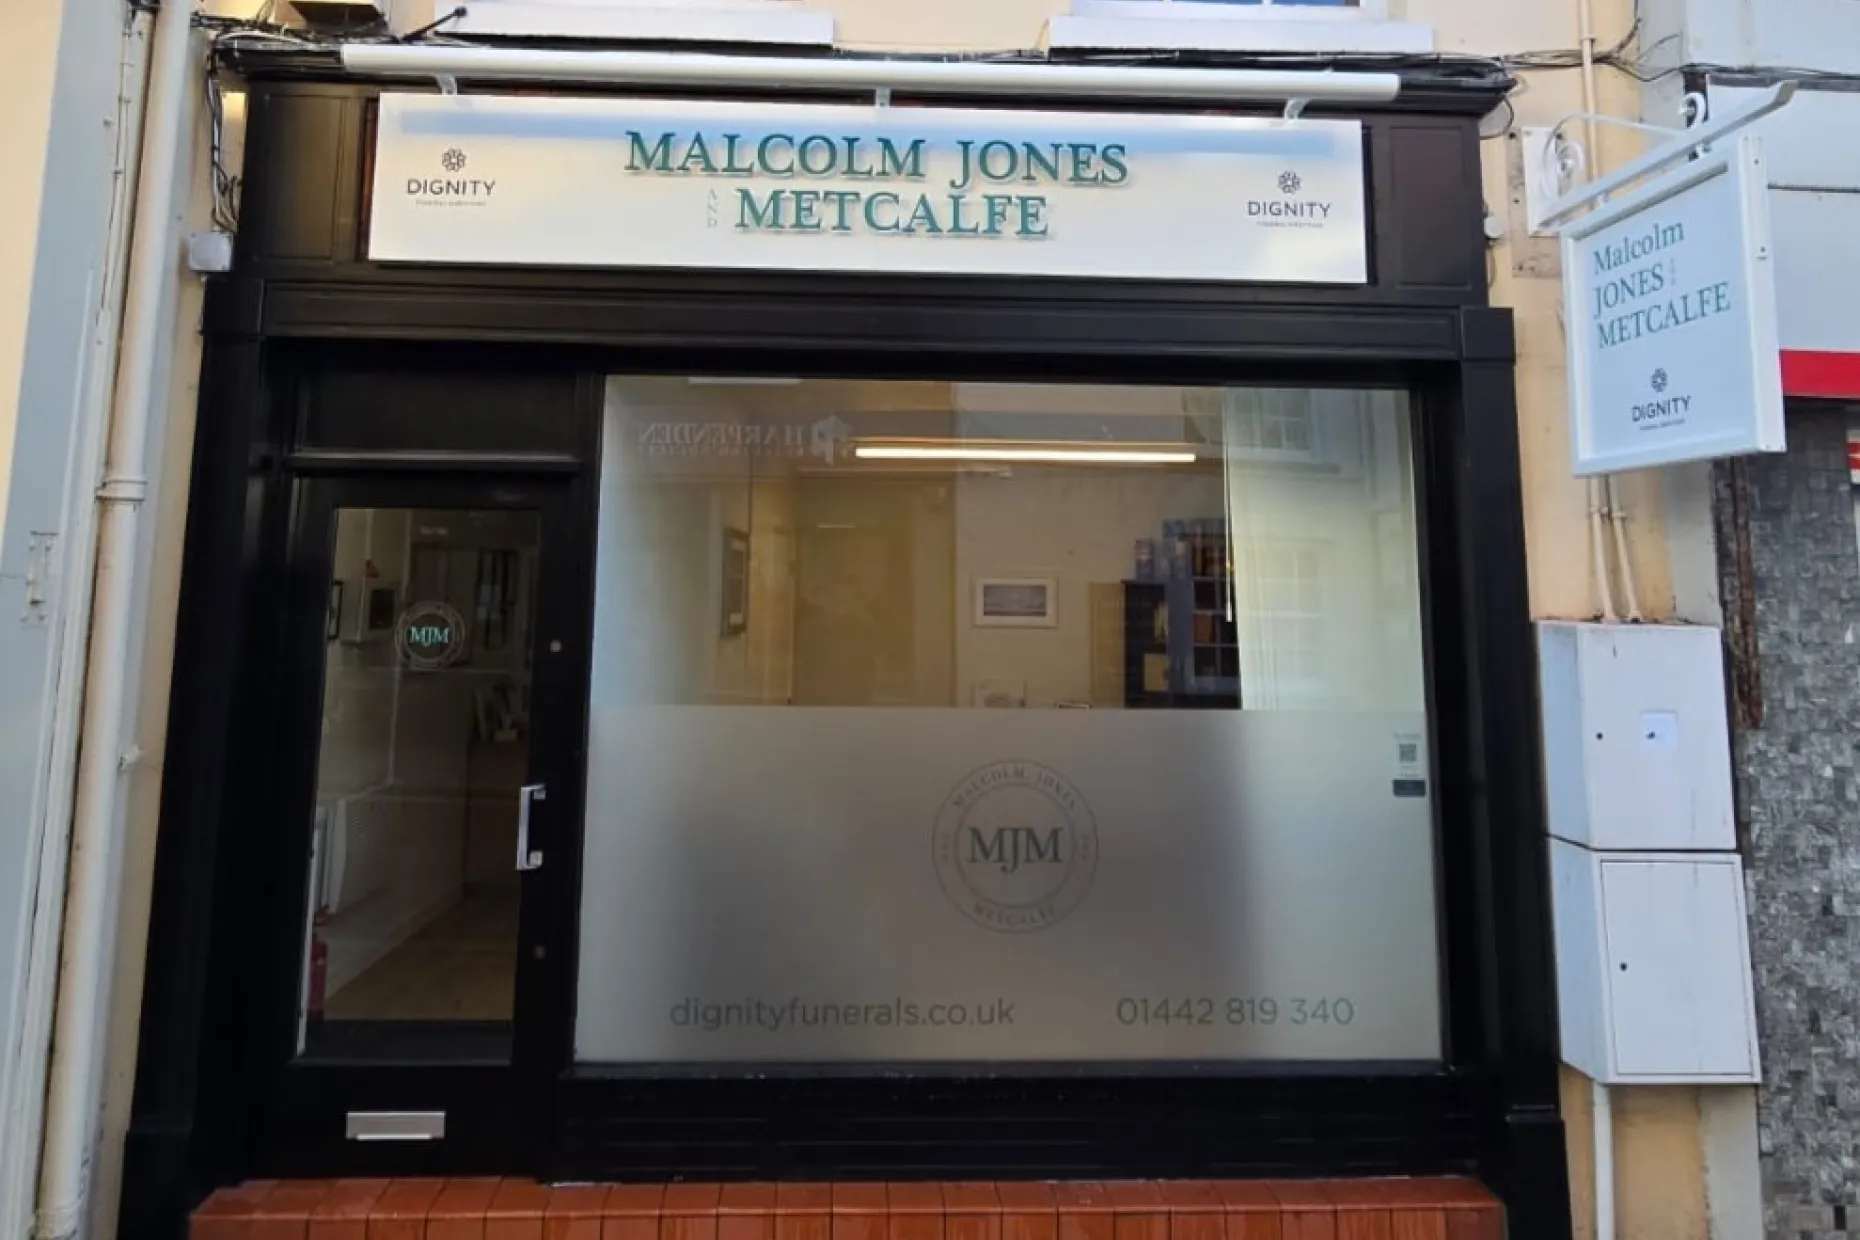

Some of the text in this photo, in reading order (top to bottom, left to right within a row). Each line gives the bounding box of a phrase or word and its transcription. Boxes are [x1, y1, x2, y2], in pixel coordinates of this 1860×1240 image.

[624, 130, 1128, 189] MALCOLM JONES
[406, 178, 496, 196] DIGNITY
[734, 186, 1049, 236] METCALFE
[1247, 199, 1332, 218] DIGNITY
[1592, 222, 1684, 275] Malcolm
[1593, 262, 1665, 320] JONES
[1597, 281, 1731, 349] METCALFE
[1632, 396, 1691, 422] DIGNITY
[410, 625, 450, 647] MJM
[967, 826, 1065, 874] MJM
[669, 997, 1015, 1031] dignityfunerals.co.uk
[1116, 996, 1355, 1025] 01442 819 340
